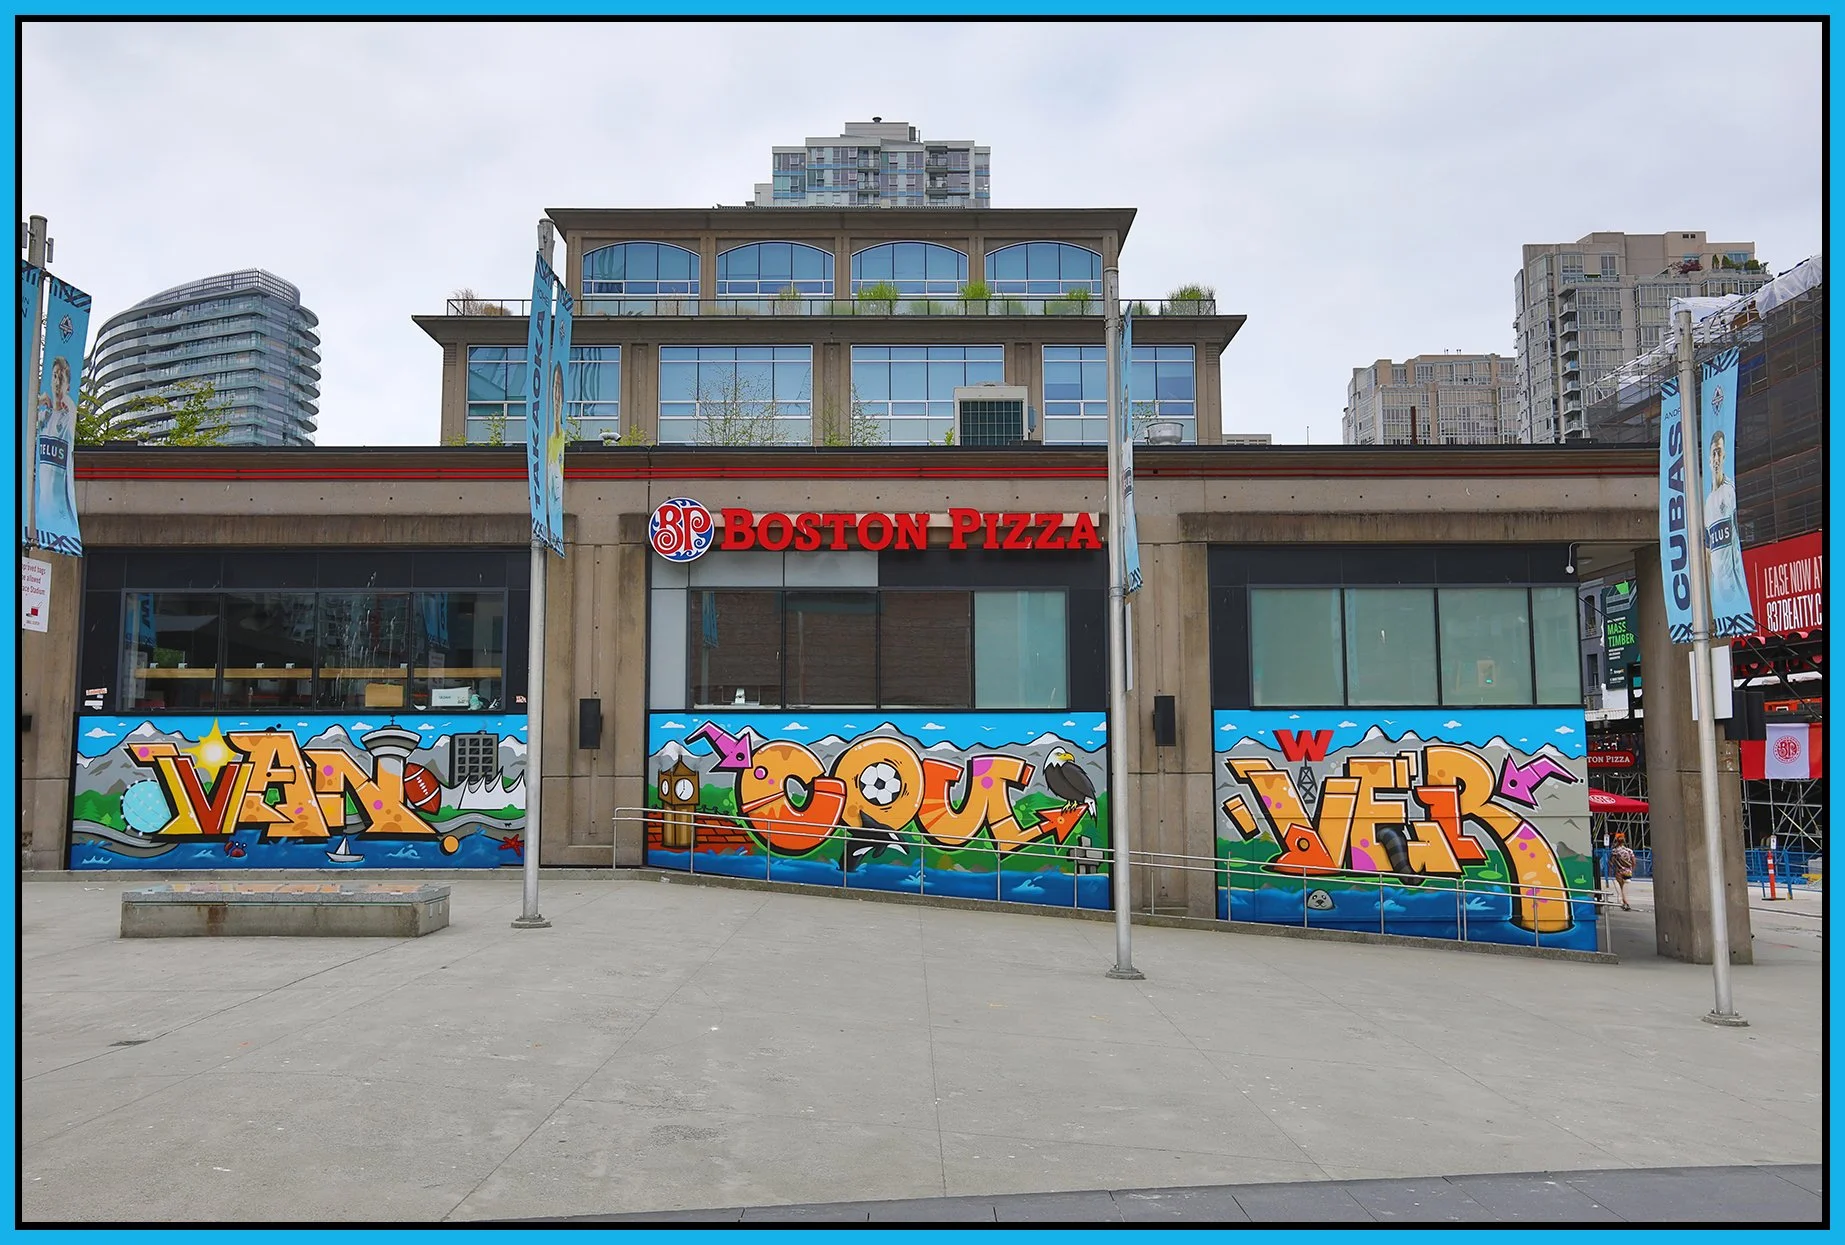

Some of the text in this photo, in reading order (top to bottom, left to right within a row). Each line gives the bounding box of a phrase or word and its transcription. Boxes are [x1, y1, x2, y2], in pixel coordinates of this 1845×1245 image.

[532, 310, 546, 510] TAKAOKA
[720, 507, 1102, 551] BOSTON PIZZA
[1668, 420, 1691, 612] CUBAS
[1764, 563, 1790, 599] LEASE
[1789, 558, 1812, 594] NOW
[1607, 621, 1627, 636] MASS
[1608, 633, 1635, 648] TIMBER
[1605, 755, 1630, 763] PIZZA
